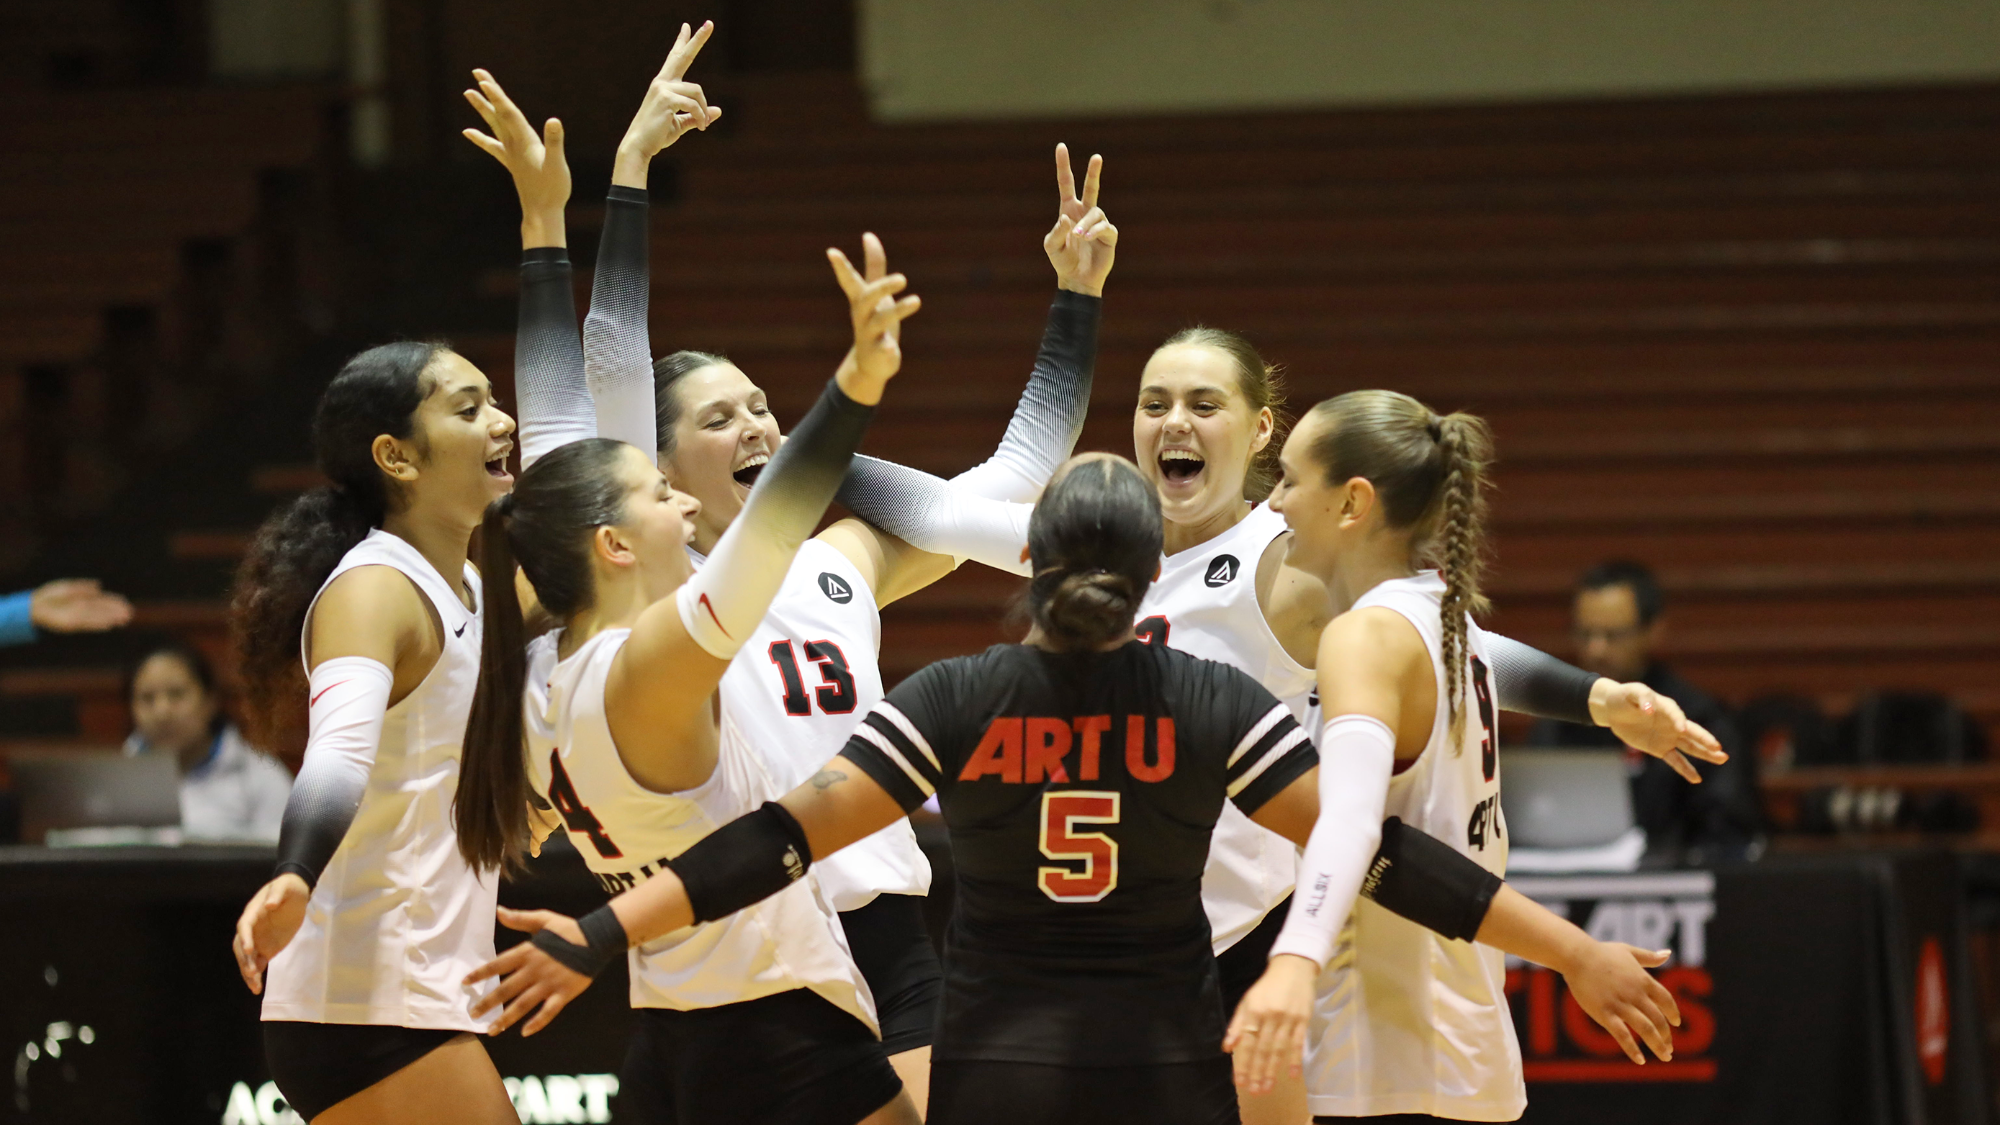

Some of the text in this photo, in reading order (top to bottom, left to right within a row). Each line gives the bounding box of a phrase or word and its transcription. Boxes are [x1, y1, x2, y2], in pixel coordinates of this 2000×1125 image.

[768, 638, 858, 717] 13
[1470, 654, 1496, 784] 9
[548, 747, 624, 859] 4
[958, 714, 1177, 784] ART U
[1038, 790, 1120, 903] 5
